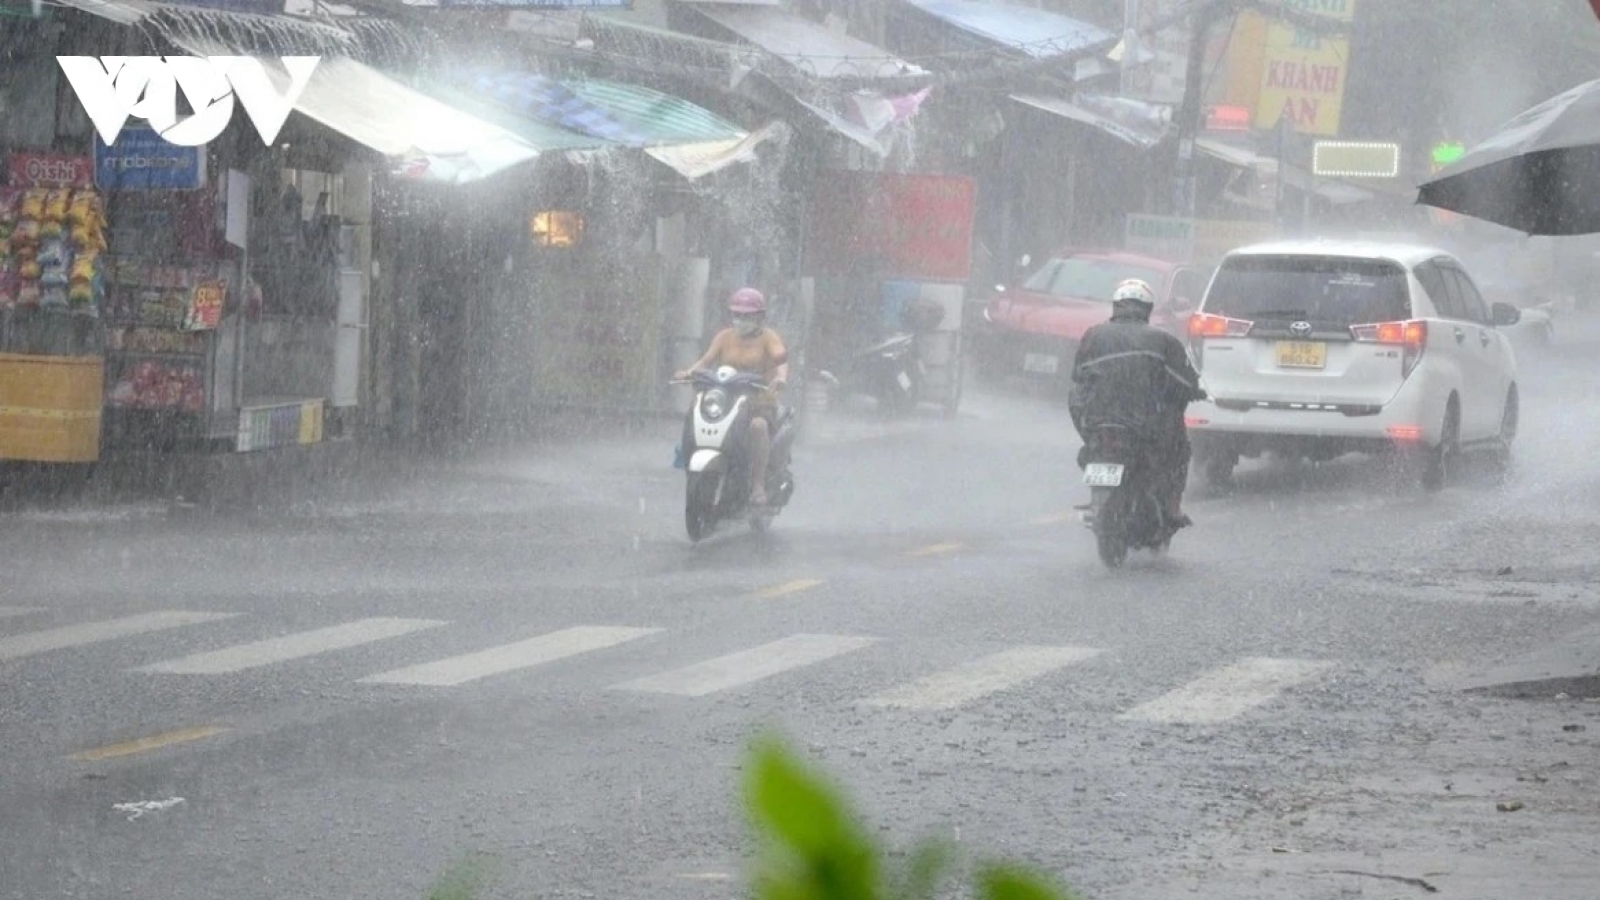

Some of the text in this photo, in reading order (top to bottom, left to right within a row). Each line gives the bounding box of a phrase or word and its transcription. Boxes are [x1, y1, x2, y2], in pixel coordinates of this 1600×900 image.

[1265, 54, 1339, 93] KHÁNH
[1282, 96, 1318, 126] AN
[26, 158, 76, 181] Oishi
